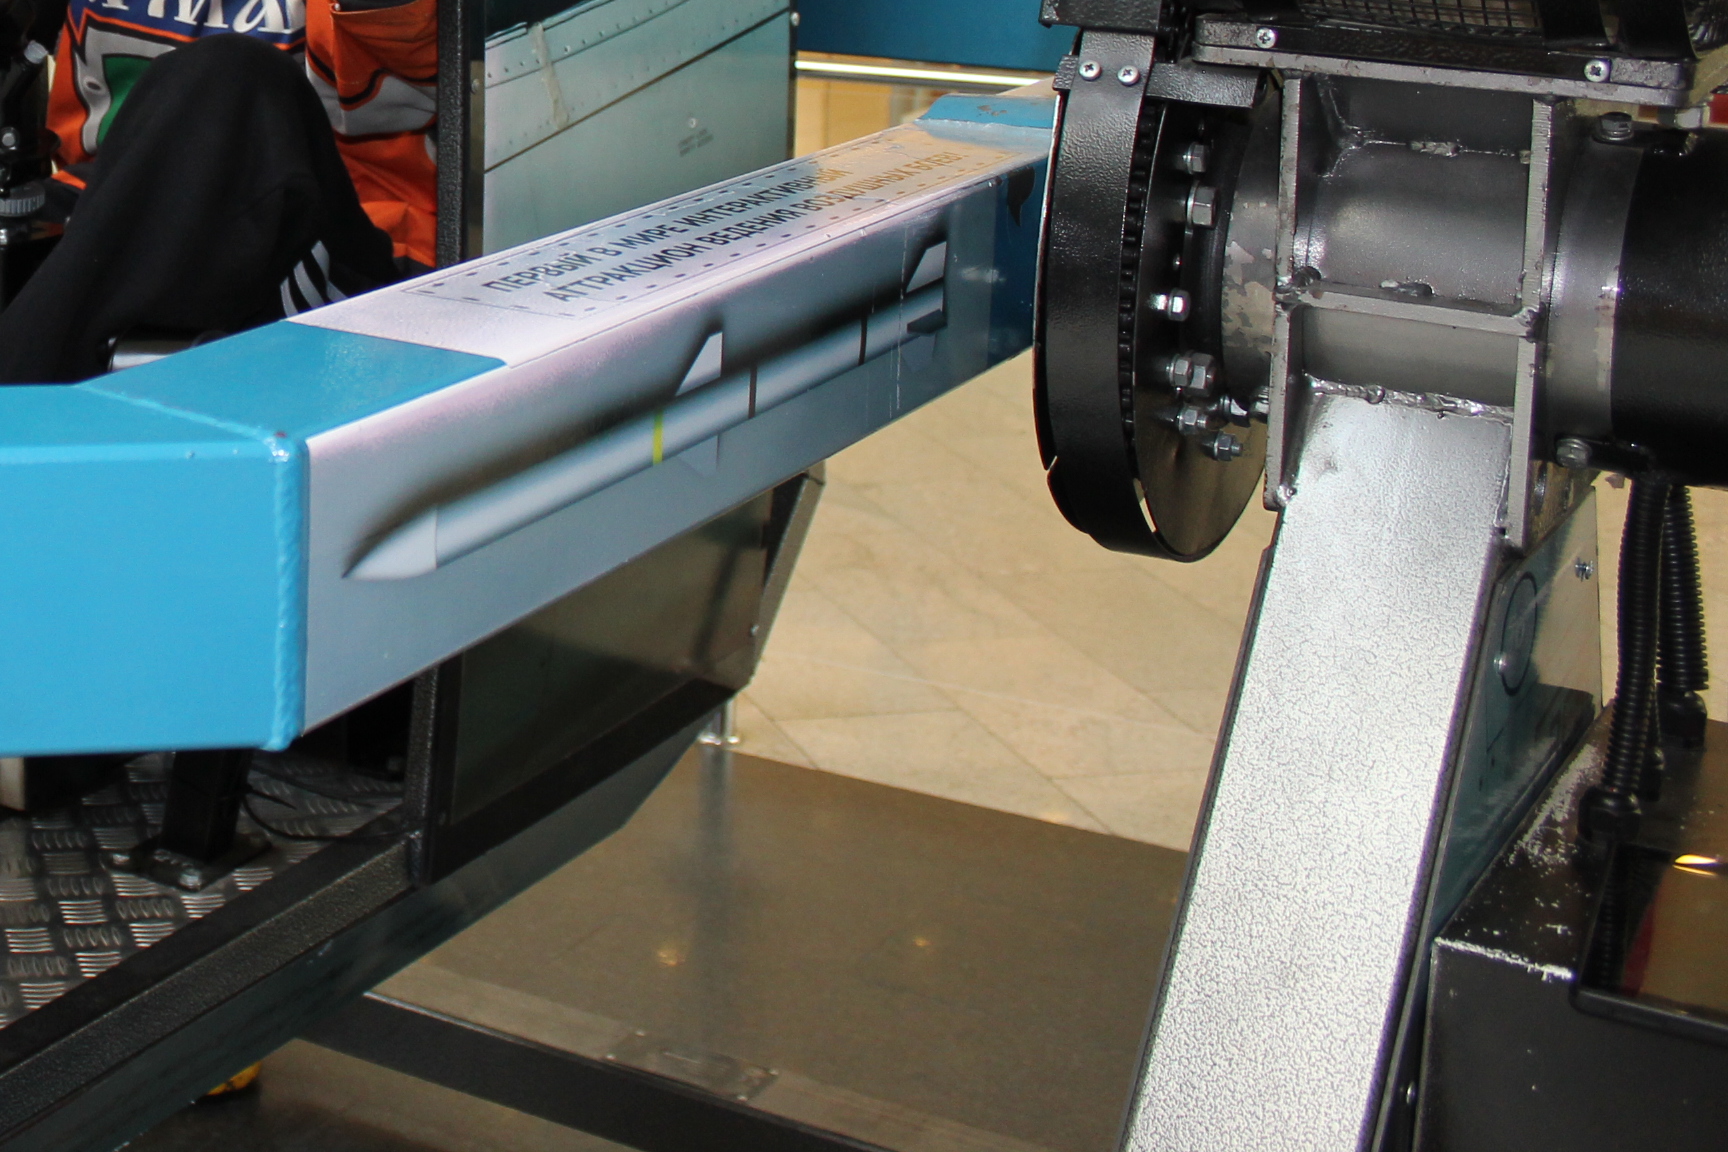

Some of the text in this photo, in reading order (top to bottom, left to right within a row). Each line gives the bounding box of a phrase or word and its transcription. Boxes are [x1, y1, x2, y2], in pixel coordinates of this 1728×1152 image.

[482, 168, 852, 293] ПЕРВЫЙ В МИРЕ ИНТЕРАКТИВНЫЙ
[543, 151, 970, 302] АТТРАКЦИОН ВЕДЕНИЯ ВОЗДУШНЫХ БОЕВ!
